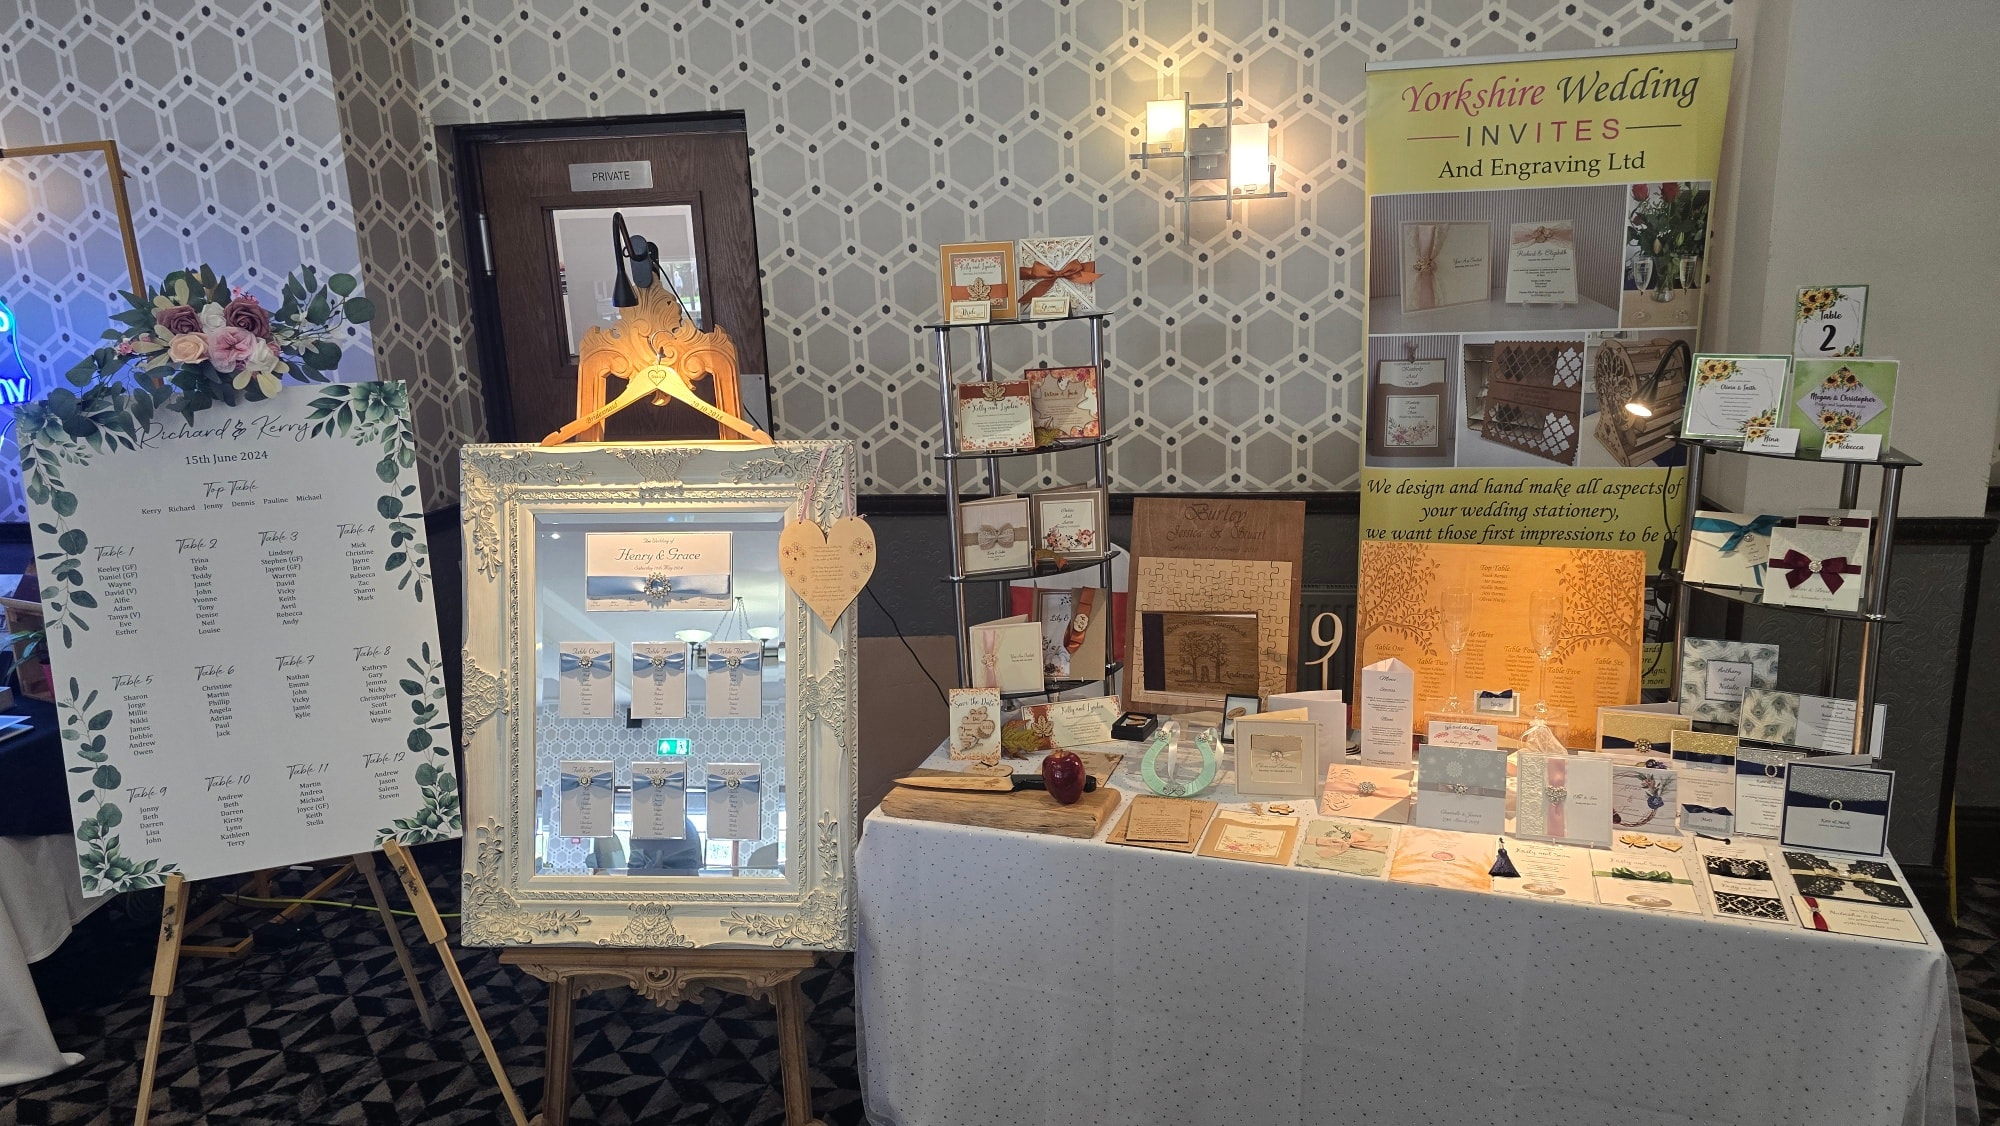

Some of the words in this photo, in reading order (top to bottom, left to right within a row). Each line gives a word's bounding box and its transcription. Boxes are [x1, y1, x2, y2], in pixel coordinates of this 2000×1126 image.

[1401, 76, 1546, 116] Yorkshire
[1556, 66, 1701, 109] Wedding
[1467, 118, 1620, 147] INVITES
[1438, 158, 1483, 179] And
[1491, 154, 1601, 182] Engraving
[1608, 151, 1646, 171] Ltd
[592, 171, 630, 182] PRIVATE
[1818, 310, 1842, 321] Table
[1819, 324, 1837, 352] 2
[1810, 391, 1832, 402] Megan
[1840, 393, 1876, 403] Christopher
[586, 401, 618, 424] Bridesmaid
[133, 418, 232, 449] Richard
[231, 419, 247, 441] &
[251, 415, 311, 442] Kerry
[1838, 443, 1864, 451] Rebecca
[184, 454, 210, 466] 15th
[213, 453, 238, 464] June
[240, 450, 269, 462] 2024
[203, 482, 225, 499] Top
[228, 480, 258, 496] Table
[1367, 479, 1392, 495] We
[1395, 478, 1445, 501] design
[1449, 478, 1480, 494] and
[1484, 477, 1524, 494] hand
[1528, 478, 1571, 496] make
[1575, 477, 1598, 494] all
[1602, 480, 1663, 501] aspects
[1667, 477, 1684, 500] of
[168, 504, 196, 513] Richard
[203, 502, 224, 511] Jenny
[231, 499, 255, 507] Dennis
[263, 496, 289, 504] Pauline
[296, 493, 322, 502] Michael
[1184, 503, 1248, 527] Burley
[1419, 506, 1458, 521] your
[1461, 501, 1527, 522] wedding
[1532, 503, 1619, 522] stationery,
[337, 523, 365, 539] Table
[367, 524, 376, 534] 4
[1167, 525, 1202, 541] Jessica
[1210, 526, 1222, 539] &
[1231, 526, 1267, 540] Stuart
[258, 530, 287, 547] Table
[290, 531, 299, 541] 3
[1366, 528, 1386, 540] we
[1391, 526, 1433, 541] want
[1437, 525, 1477, 540] those
[1477, 524, 1514, 547] first
[1520, 526, 1613, 548] impressions
[1619, 528, 1636, 542] to
[1641, 525, 1659, 542] be
[176, 538, 206, 554] Table
[209, 538, 218, 549] 2
[94, 546, 125, 561] Table
[129, 547, 134, 556] 1
[345, 549, 374, 557] Christine
[615, 548, 653, 564] Henry
[655, 550, 665, 561] &
[666, 548, 701, 561] Grace
[352, 557, 370, 565] Jayne
[1481, 564, 1492, 573] Top
[1494, 564, 1511, 572] Table
[1050, 614, 1062, 623] Lily
[1304, 612, 1343, 690] 9
[1375, 643, 1391, 651] Table
[1392, 644, 1405, 652] One
[1503, 645, 1521, 653] Table
[353, 646, 382, 661] Table
[383, 645, 391, 656] 8
[275, 655, 305, 671] Table
[307, 655, 315, 664] 7
[1417, 658, 1434, 666] Table
[1594, 657, 1612, 665] Table
[194, 665, 225, 680] Table
[227, 665, 235, 674] 6
[362, 664, 388, 672] Kathryn
[1547, 666, 1565, 674] Table
[1717, 666, 1742, 676] Anthony
[1222, 671, 1255, 679] Andrew
[112, 675, 142, 691] Table
[145, 675, 154, 684] 5
[202, 683, 232, 691] Christine
[366, 679, 388, 687] Jemma
[1719, 683, 1740, 691] Natalie
[368, 686, 386, 694] Nicky
[207, 691, 230, 699] Martin
[360, 693, 397, 702] Christopher
[980, 697, 996, 707] Date
[210, 714, 233, 722] Adrian
[370, 716, 392, 724] Wayne
[129, 733, 154, 741] Debbie
[216, 730, 231, 738] Jack
[128, 741, 156, 749] Andrew
[363, 753, 390, 768] Table
[394, 752, 406, 762] 12
[287, 763, 315, 780] Table
[318, 763, 329, 773] 11
[205, 775, 235, 792] Table
[237, 774, 251, 785] 10
[126, 786, 157, 803] Table
[160, 786, 168, 797] 9
[217, 793, 244, 802] Andrew
[223, 801, 239, 809] Beth
[140, 806, 159, 814] Jonny
[220, 809, 244, 817] Darren
[142, 813, 159, 821] Beth
[223, 817, 244, 825] Kirsty
[140, 821, 164, 829] Darren
[226, 824, 243, 832] Lynn
[220, 831, 250, 840] Kathleen
[146, 837, 162, 845] John
